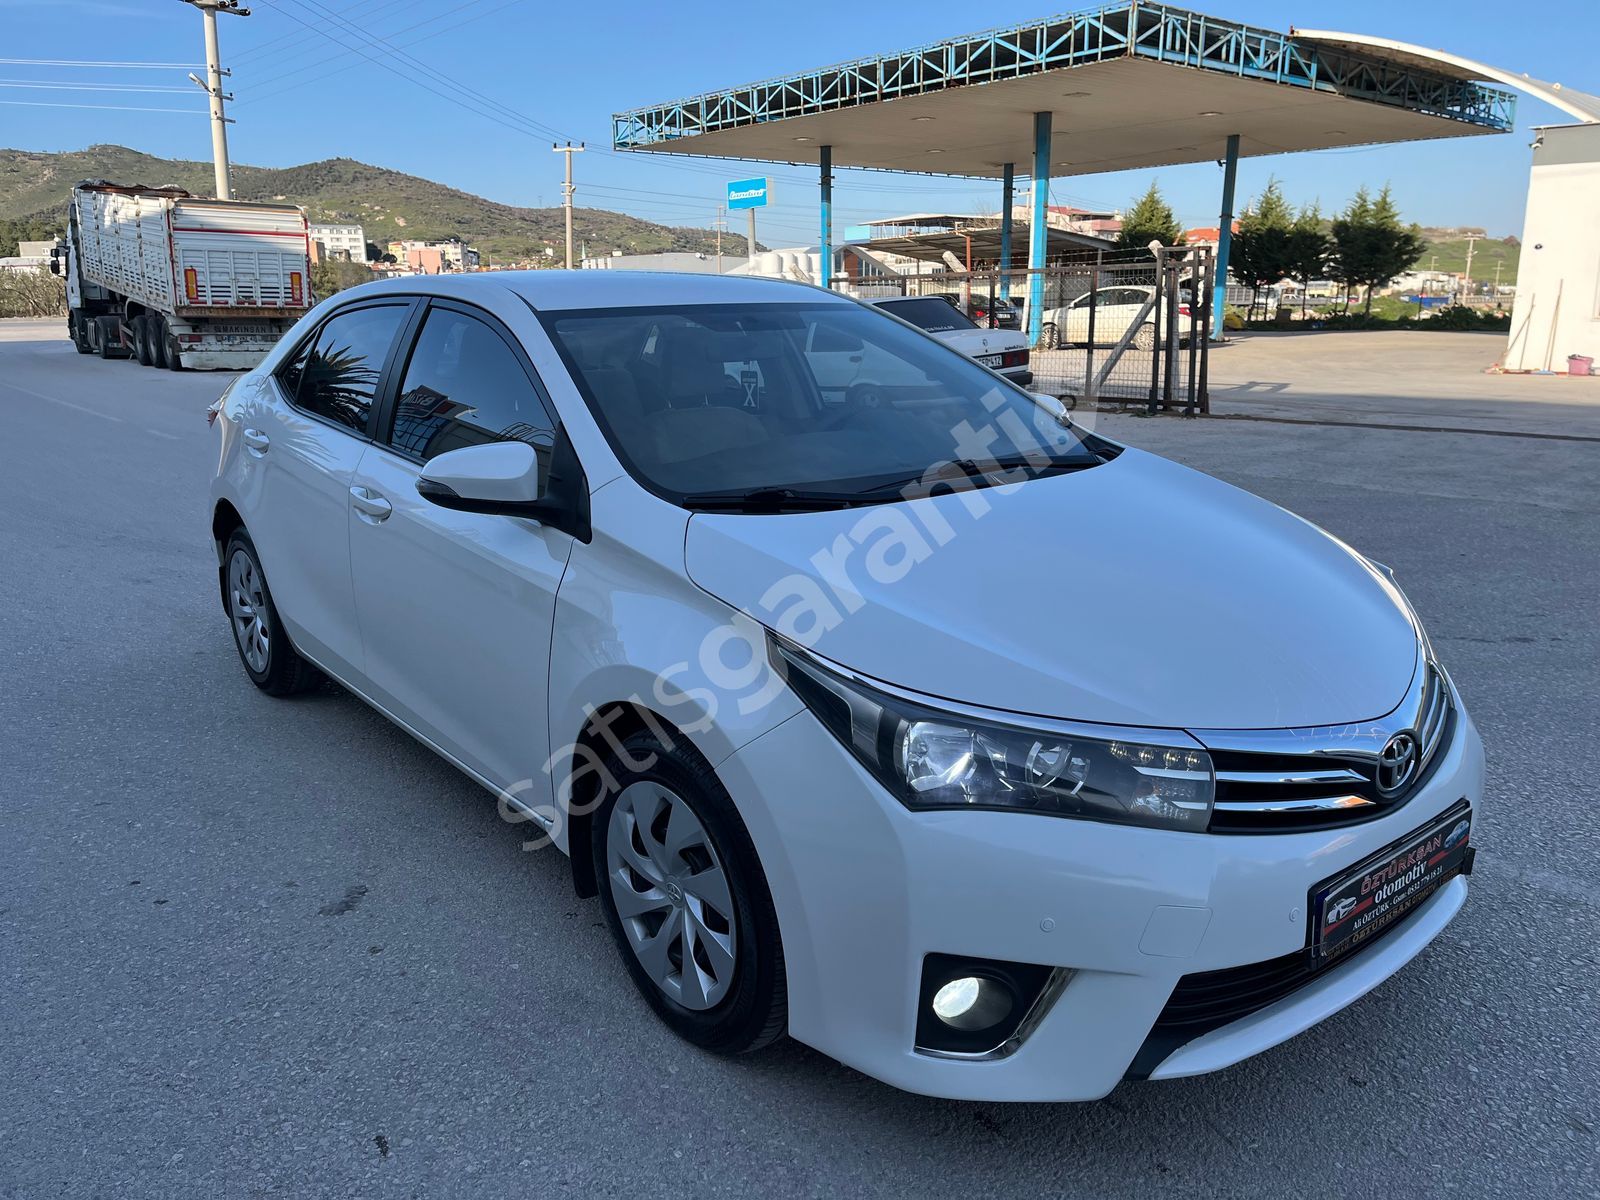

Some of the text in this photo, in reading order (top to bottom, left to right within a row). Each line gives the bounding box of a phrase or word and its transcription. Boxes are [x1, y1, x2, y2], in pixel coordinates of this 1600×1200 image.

[1375, 860, 1427, 904] otomotiv
[1353, 918, 1362, 931] Ali
[1362, 901, 1389, 924] ÖZTÜRK
